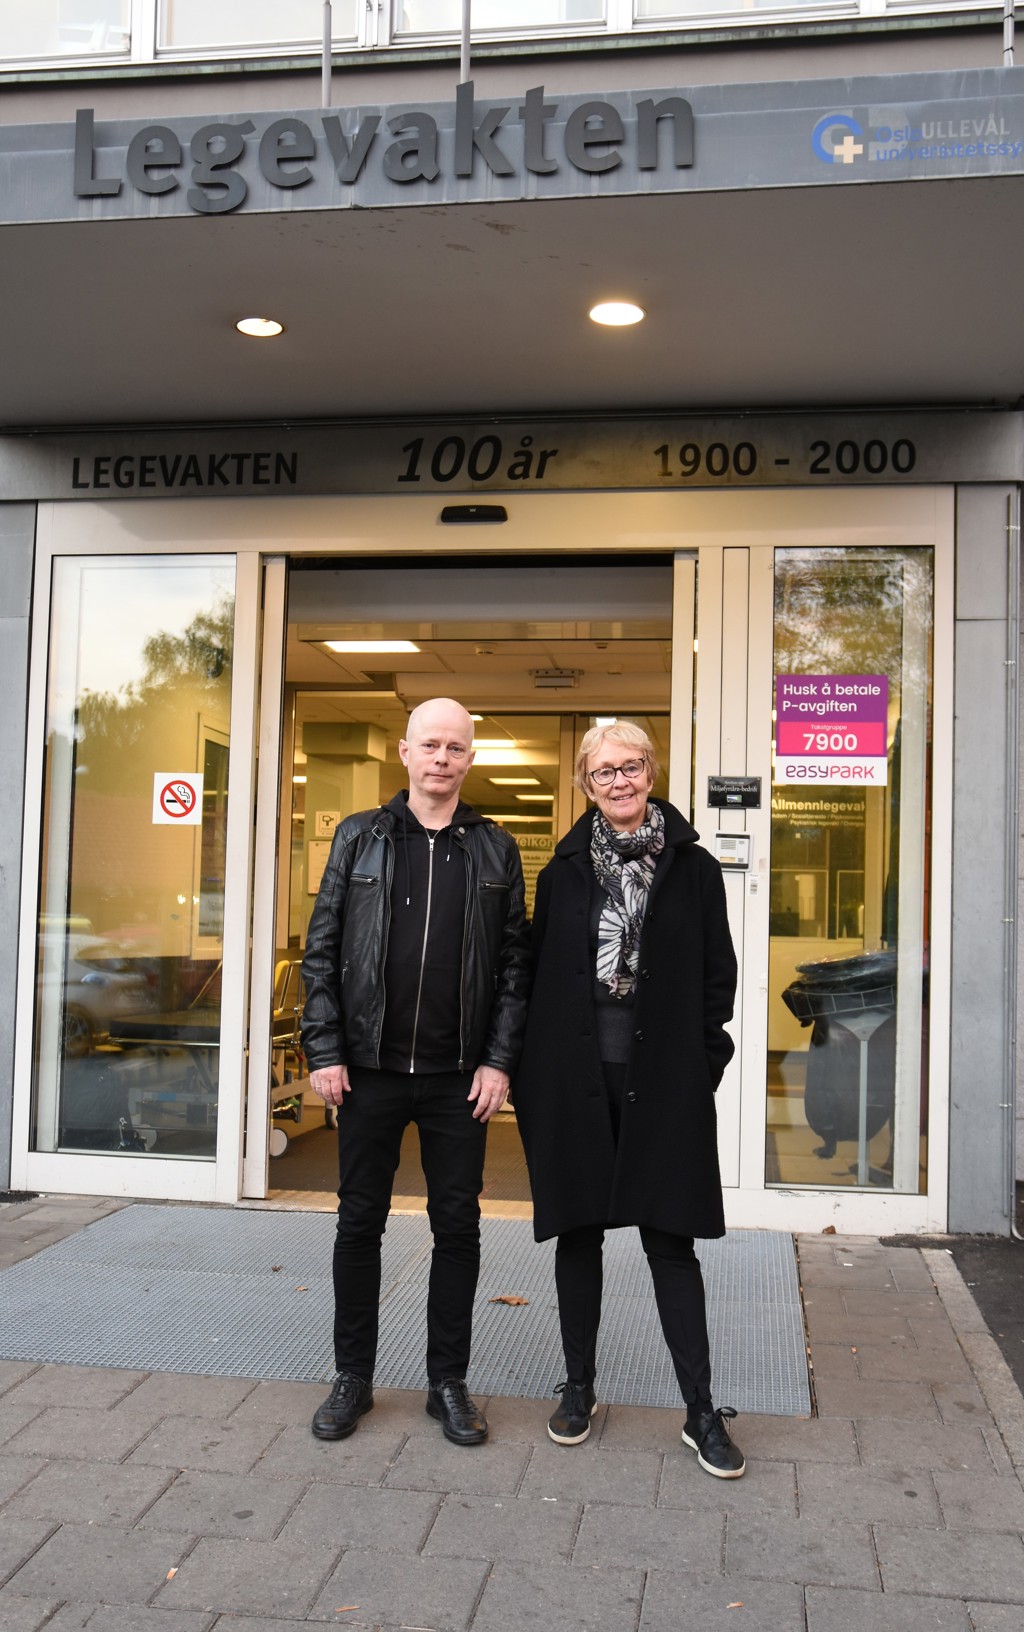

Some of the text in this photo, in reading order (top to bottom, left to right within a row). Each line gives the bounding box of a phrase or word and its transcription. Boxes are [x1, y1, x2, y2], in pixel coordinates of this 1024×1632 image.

[875, 125, 923, 143] Oslo
[921, 112, 1010, 140] ULLEVÅL
[73, 80, 694, 214] Legevakten
[876, 139, 1024, 162] universitetssy
[72, 452, 298, 489] LEGEVAKTEN
[397, 435, 503, 482] 100
[507, 435, 559, 480] år
[653, 442, 757, 477] 1900
[809, 439, 916, 474] 2000
[783, 682, 881, 696] Husk å betale
[782, 700, 857, 716] P-avgiften
[803, 733, 858, 751] 7900
